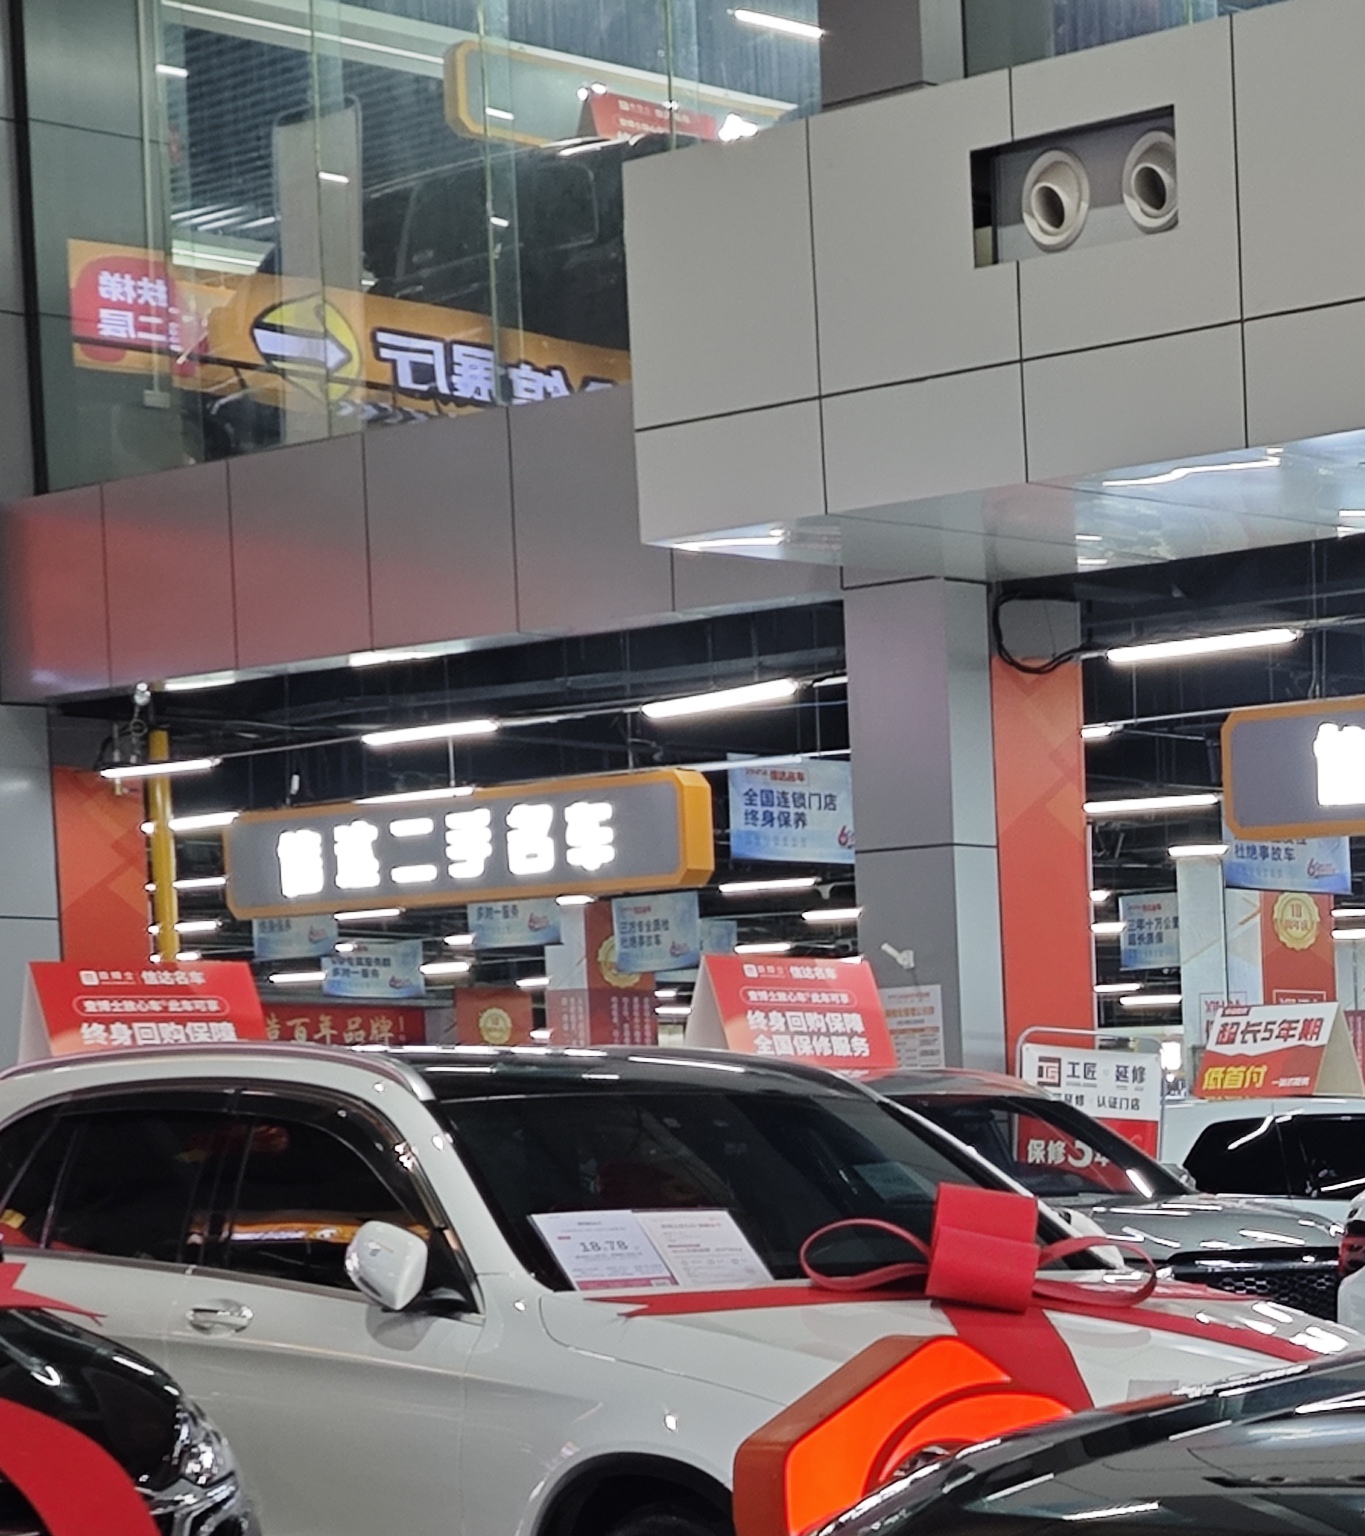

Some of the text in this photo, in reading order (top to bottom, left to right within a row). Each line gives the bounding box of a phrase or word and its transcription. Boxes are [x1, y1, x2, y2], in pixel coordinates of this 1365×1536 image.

[743, 788, 837, 811] 全国连锁门店
[743, 809, 807, 829] 终身保养
[1235, 844, 1296, 862] 杜绝事故车
[747, 1009, 865, 1033] 终身回购保障
[1216, 1017, 1325, 1047] 超长5年期
[80, 1021, 239, 1046] 终身回购保障
[753, 1034, 871, 1058] 全国保修服务
[1066, 1062, 1098, 1081] 工匠
[1202, 1064, 1268, 1090] 低首付
[1097, 1095, 1141, 1111] 认证门店
